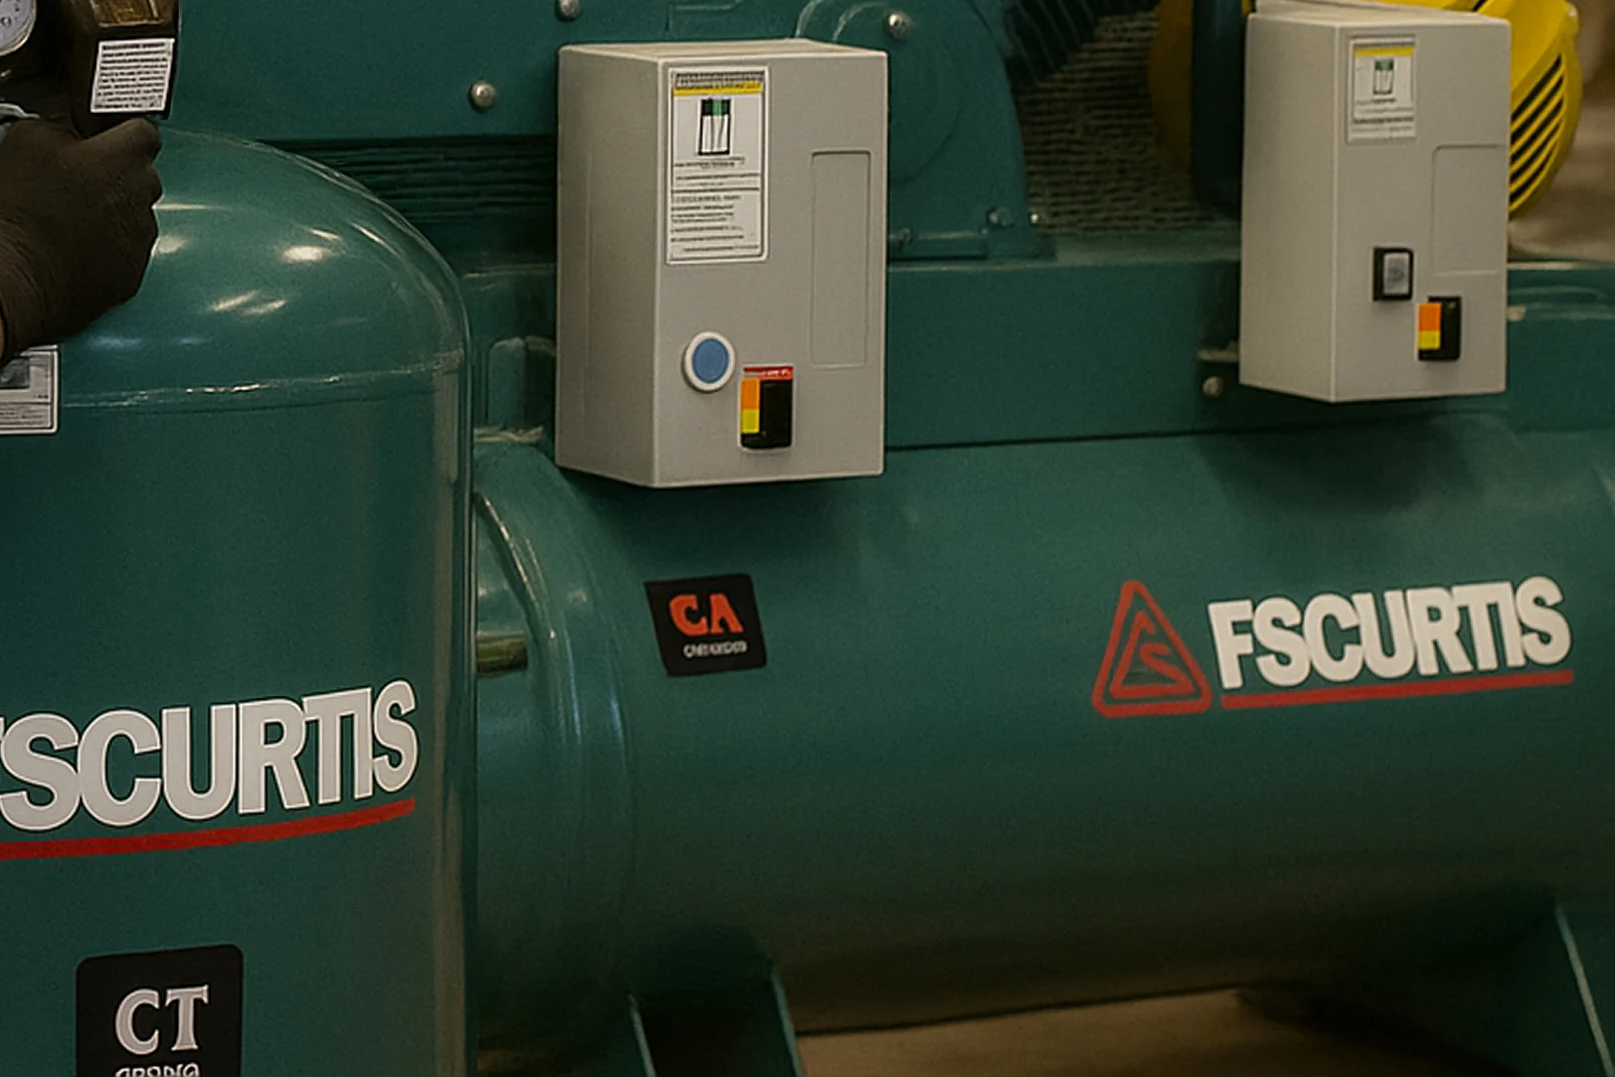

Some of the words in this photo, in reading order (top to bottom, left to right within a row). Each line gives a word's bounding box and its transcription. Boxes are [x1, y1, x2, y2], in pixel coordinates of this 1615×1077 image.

[669, 593, 744, 637] CA
[1208, 576, 1572, 689] FSCURTIS
[115, 984, 209, 1055] CT
